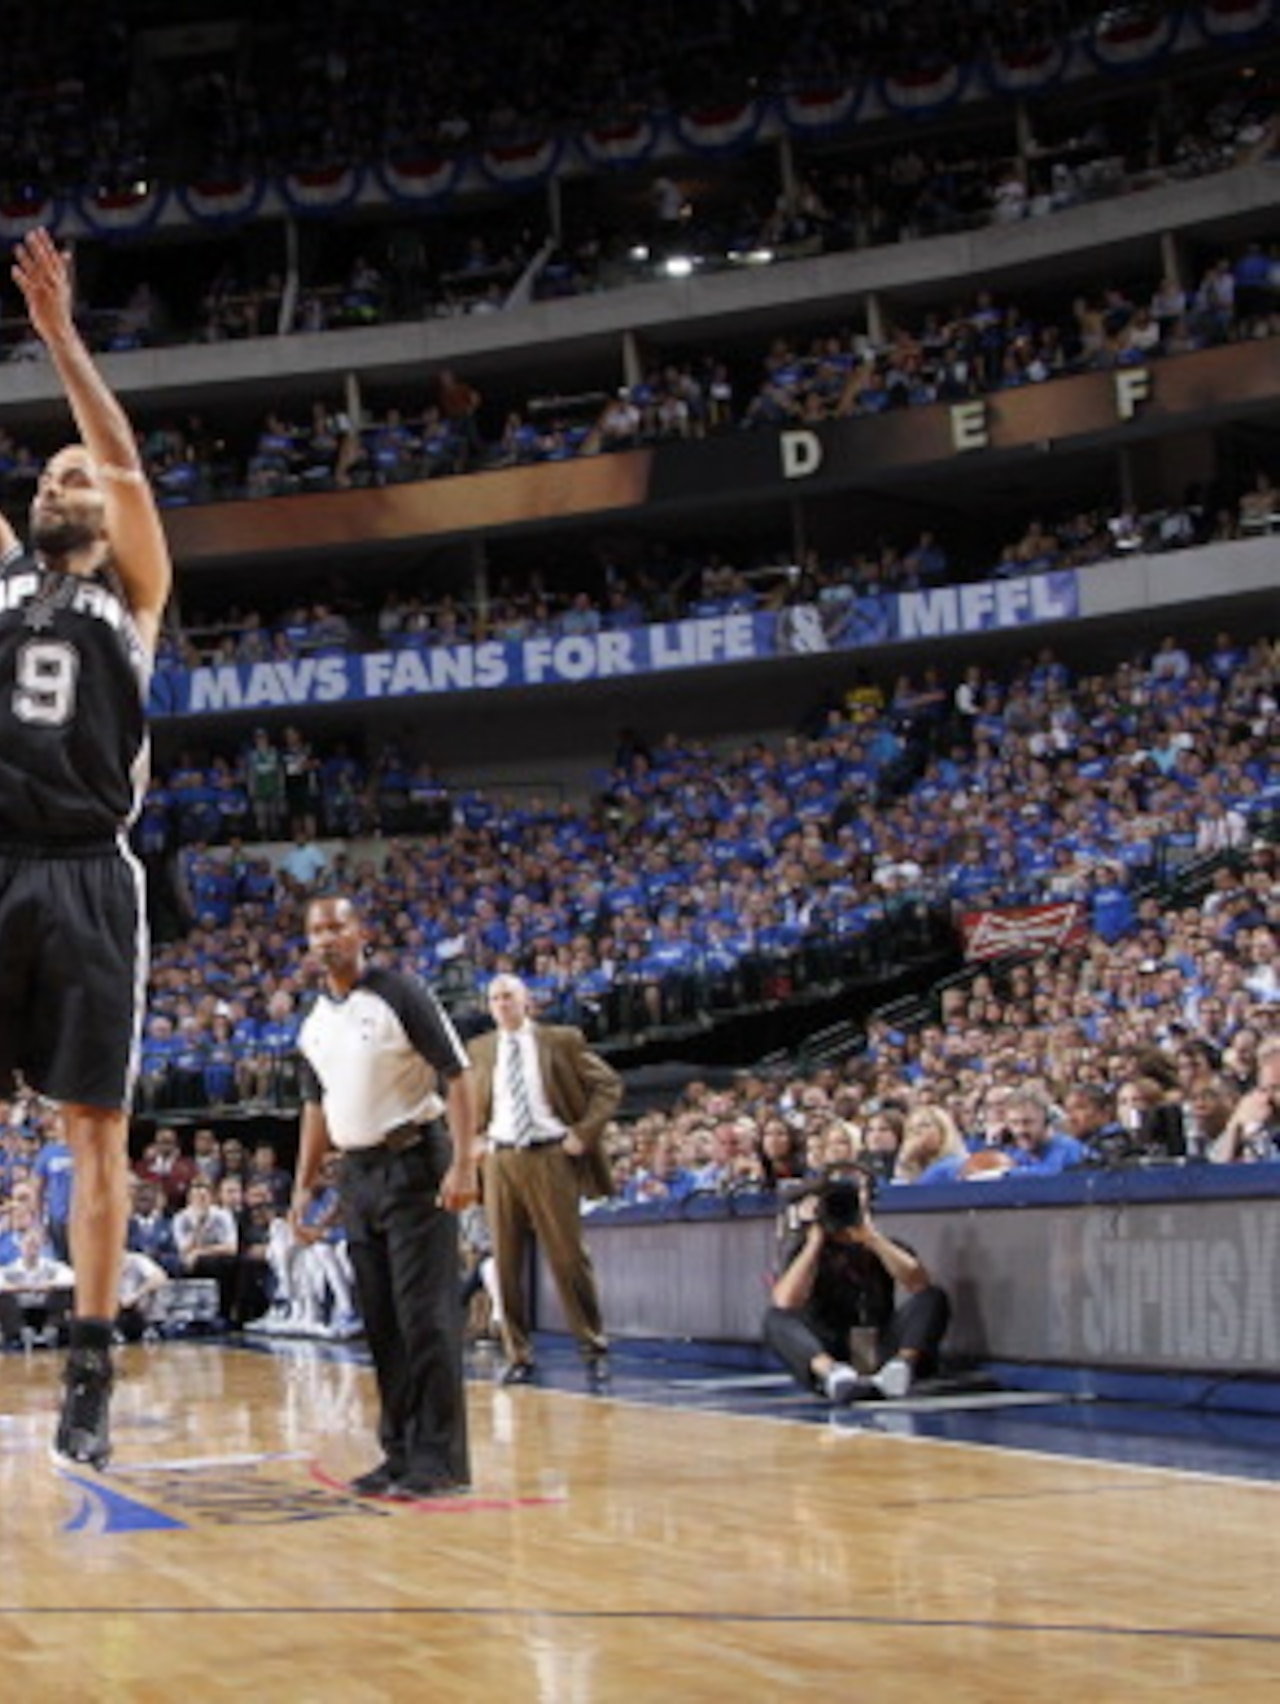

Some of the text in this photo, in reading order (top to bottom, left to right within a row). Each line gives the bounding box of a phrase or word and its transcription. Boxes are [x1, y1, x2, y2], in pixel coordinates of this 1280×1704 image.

[780, 369, 1148, 479] D E F
[11, 636, 81, 727] 9
[188, 656, 348, 712] MAVS
[362, 641, 510, 697] FANS
[521, 630, 636, 684] FOR
[650, 614, 756, 670] LIFE
[898, 574, 1064, 638] MFFL
